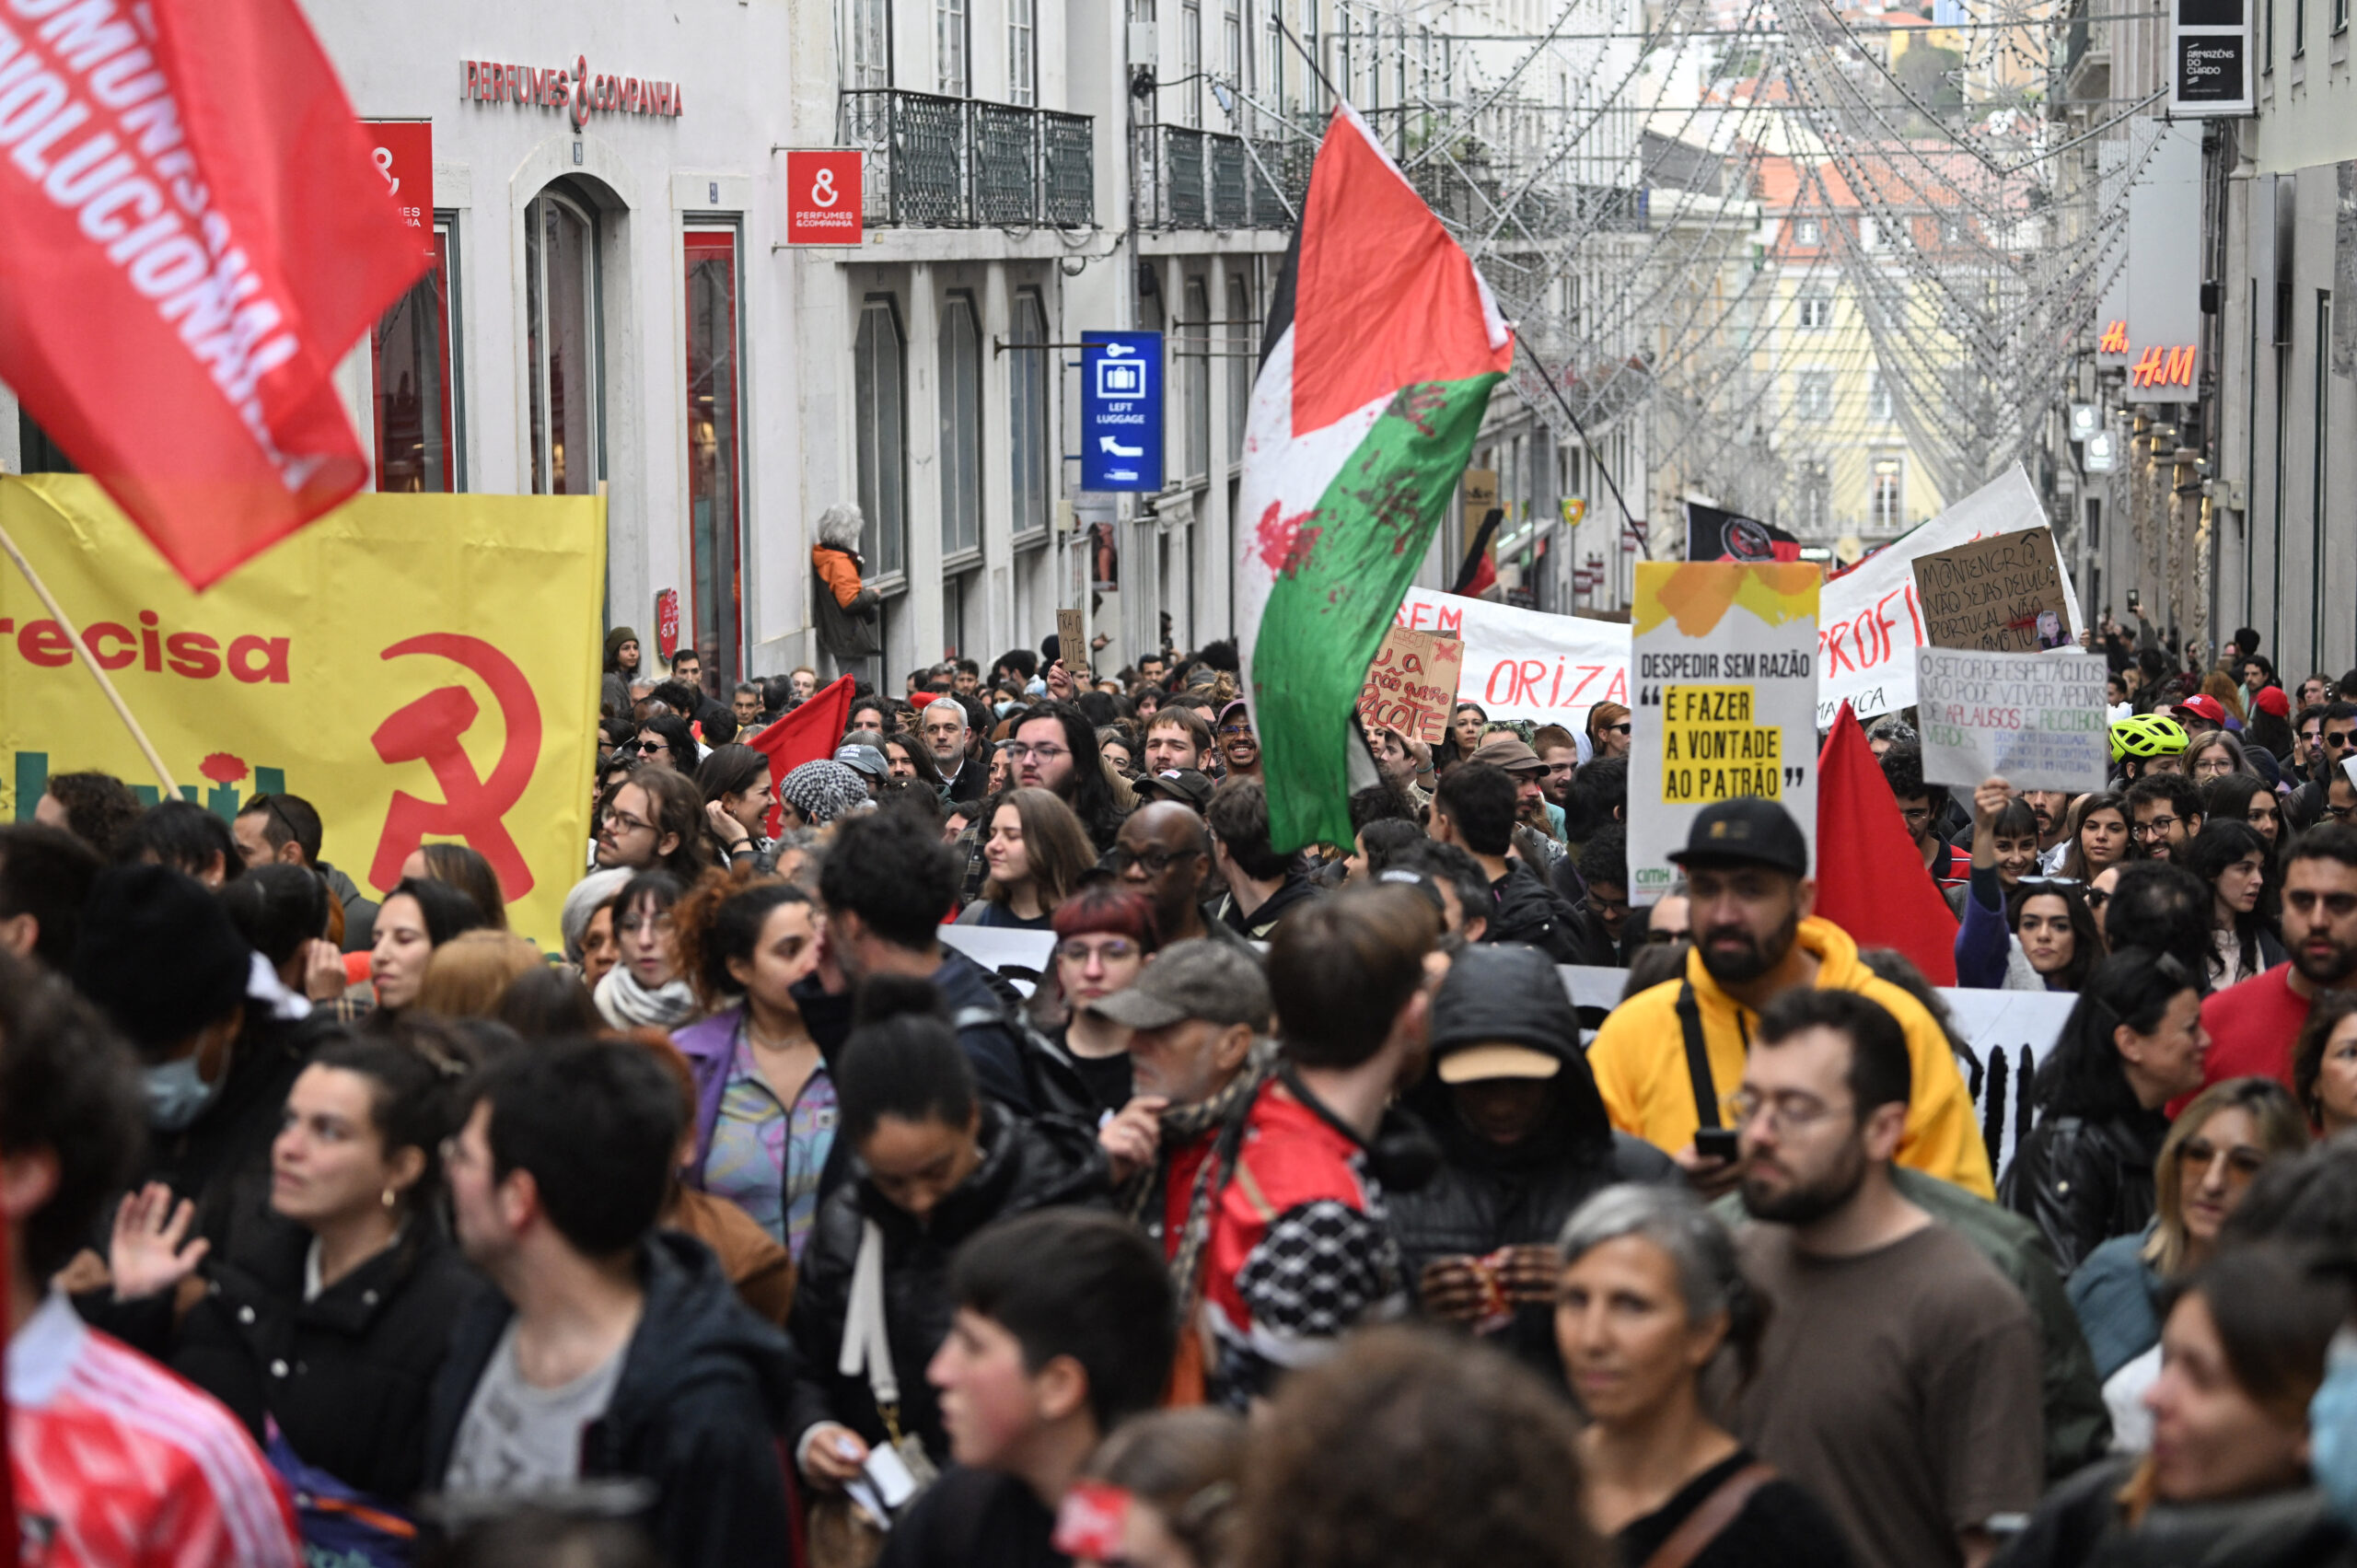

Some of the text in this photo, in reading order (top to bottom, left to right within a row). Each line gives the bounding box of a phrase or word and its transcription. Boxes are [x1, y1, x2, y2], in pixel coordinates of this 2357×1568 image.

[2187, 59, 2201, 67] DO
[2187, 66, 2222, 75] CHIADO
[464, 60, 570, 108] PERFUMES
[592, 74, 683, 117] COMPANHIA
[795, 211, 853, 219] PERFUMES
[2131, 343, 2196, 388] H&M
[1096, 413, 1145, 424] LUGGAGE
[1108, 401, 1133, 412] LEFT
[1924, 590, 1962, 620] NÃO
[1962, 578, 2003, 609] SEJAS
[1927, 608, 2003, 646] PORTUGAL
[1641, 649, 1810, 679] DESPEDIR SEM RAZÃO
[1934, 656, 1982, 679] SETOR
[1984, 657, 2003, 681] DE
[2005, 658, 2106, 683] ESPETÁCULOS
[1686, 692, 1750, 721] FAZER
[1955, 680, 1993, 704] PODE
[1999, 682, 2054, 706] VIVER
[1357, 683, 1446, 741] PACOTE
[1922, 702, 1942, 723] DE
[1945, 703, 2021, 729] APLAUSOS
[2038, 708, 2107, 732] RECIBOS
[1666, 729, 1778, 761] A VONTADE
[1666, 768, 1692, 799] AO
